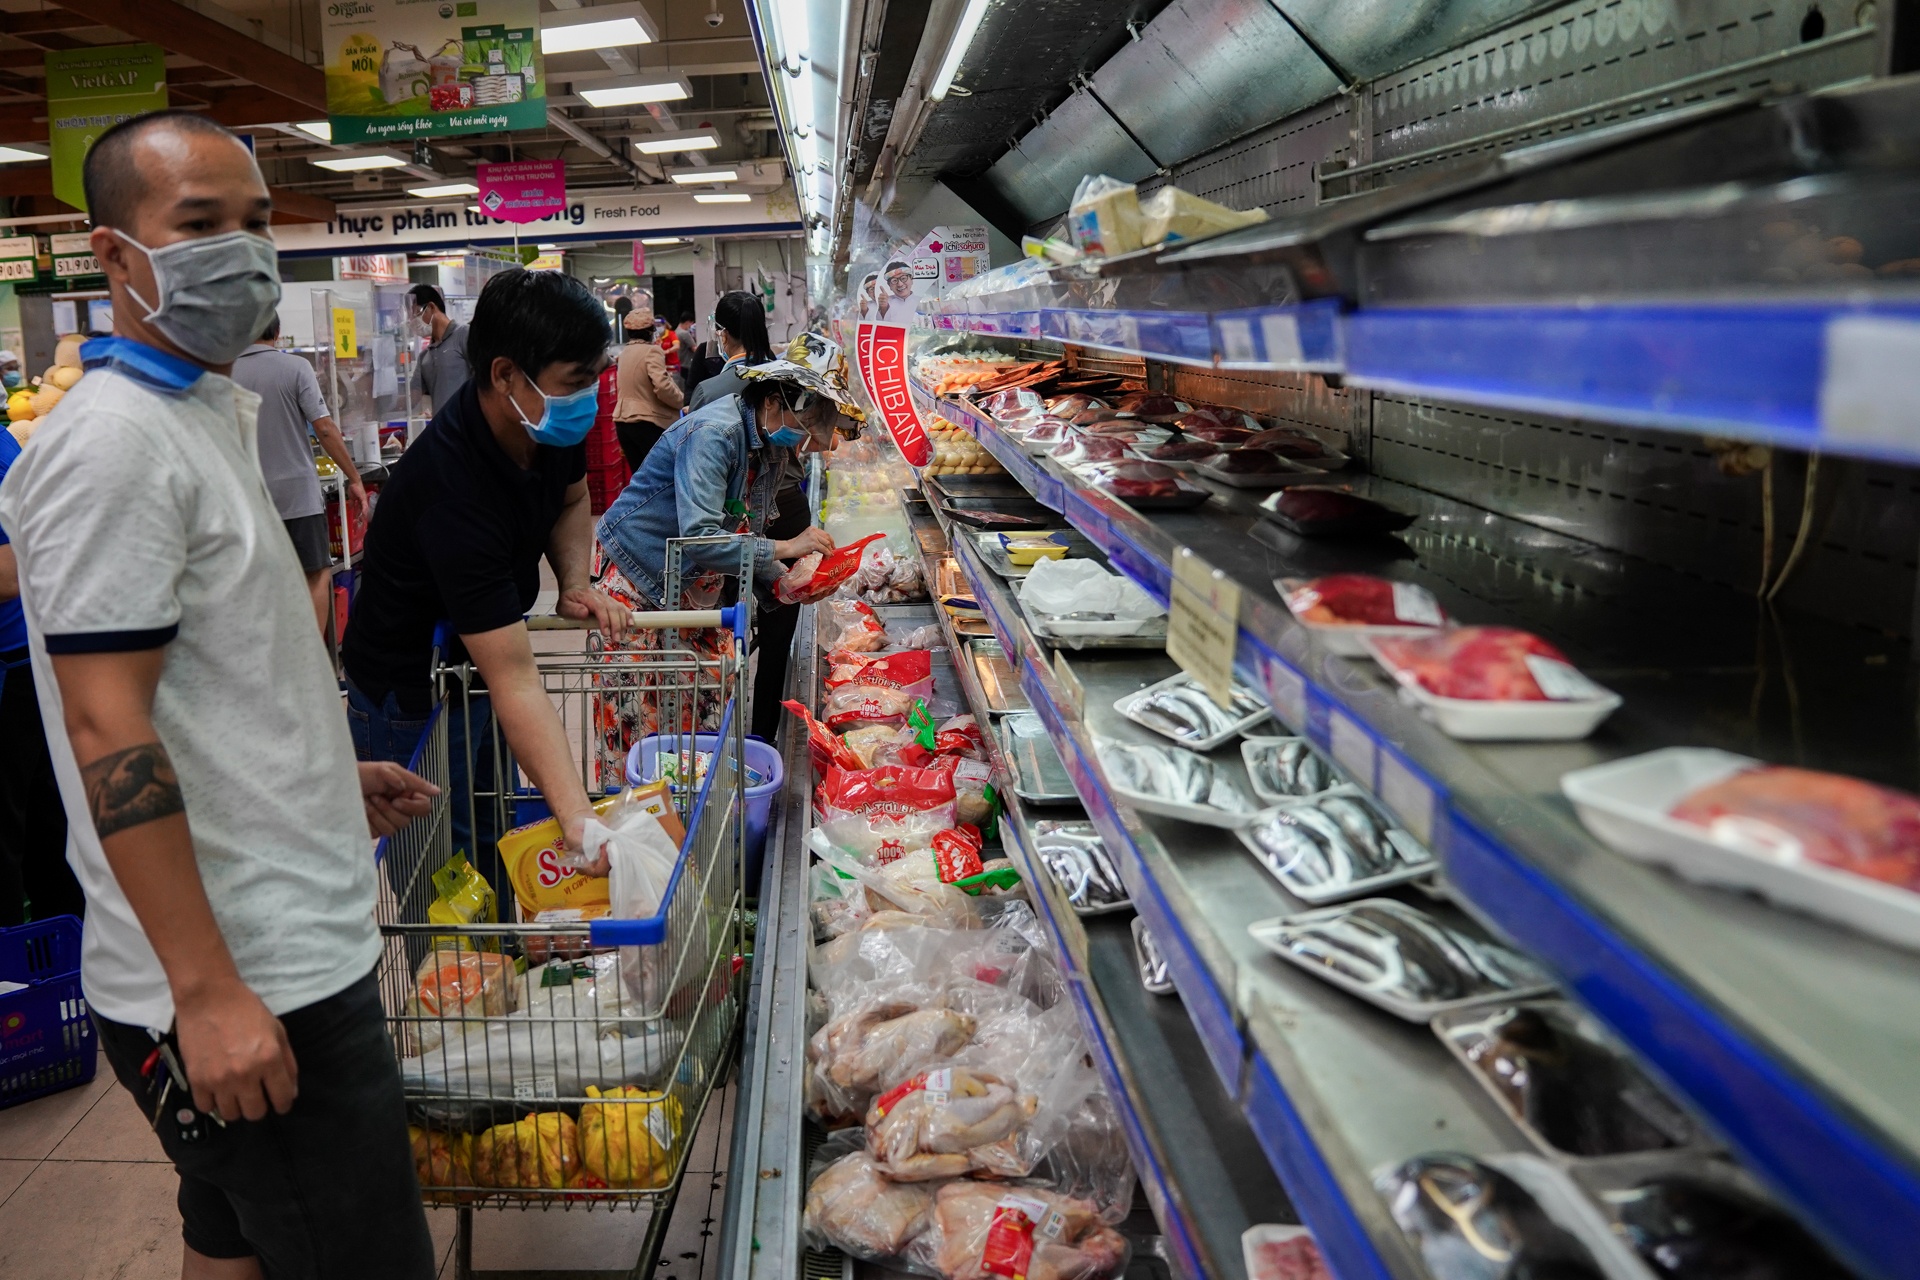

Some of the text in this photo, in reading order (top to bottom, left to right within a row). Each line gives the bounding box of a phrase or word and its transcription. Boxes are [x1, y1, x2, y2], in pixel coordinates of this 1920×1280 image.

[328, 3, 375, 18] Organic
[352, 56, 372, 72] MỚI
[71, 71, 138, 88] VietGAP
[56, 115, 86, 128] NHÓM
[90, 116, 111, 127] THỊT
[366, 123, 376, 134] Ăn
[378, 125, 395, 136] ngon
[398, 121, 413, 134] sống
[450, 117, 462, 127] Vui
[489, 115, 508, 127] ngày
[503, 165, 517, 173] VỰC
[534, 162, 553, 170] HÀNG
[527, 172, 555, 180] TRƯỜNG
[392, 206, 457, 236] phẩm
[594, 207, 626, 219] Fresh
[630, 204, 660, 216] Food
[57, 259, 98, 272] 51.900
[350, 254, 394, 275] VISSAN
[876, 339, 922, 447] ICHIBAN
[862, 704, 881, 714] 100%
[878, 847, 905, 859] 100%
